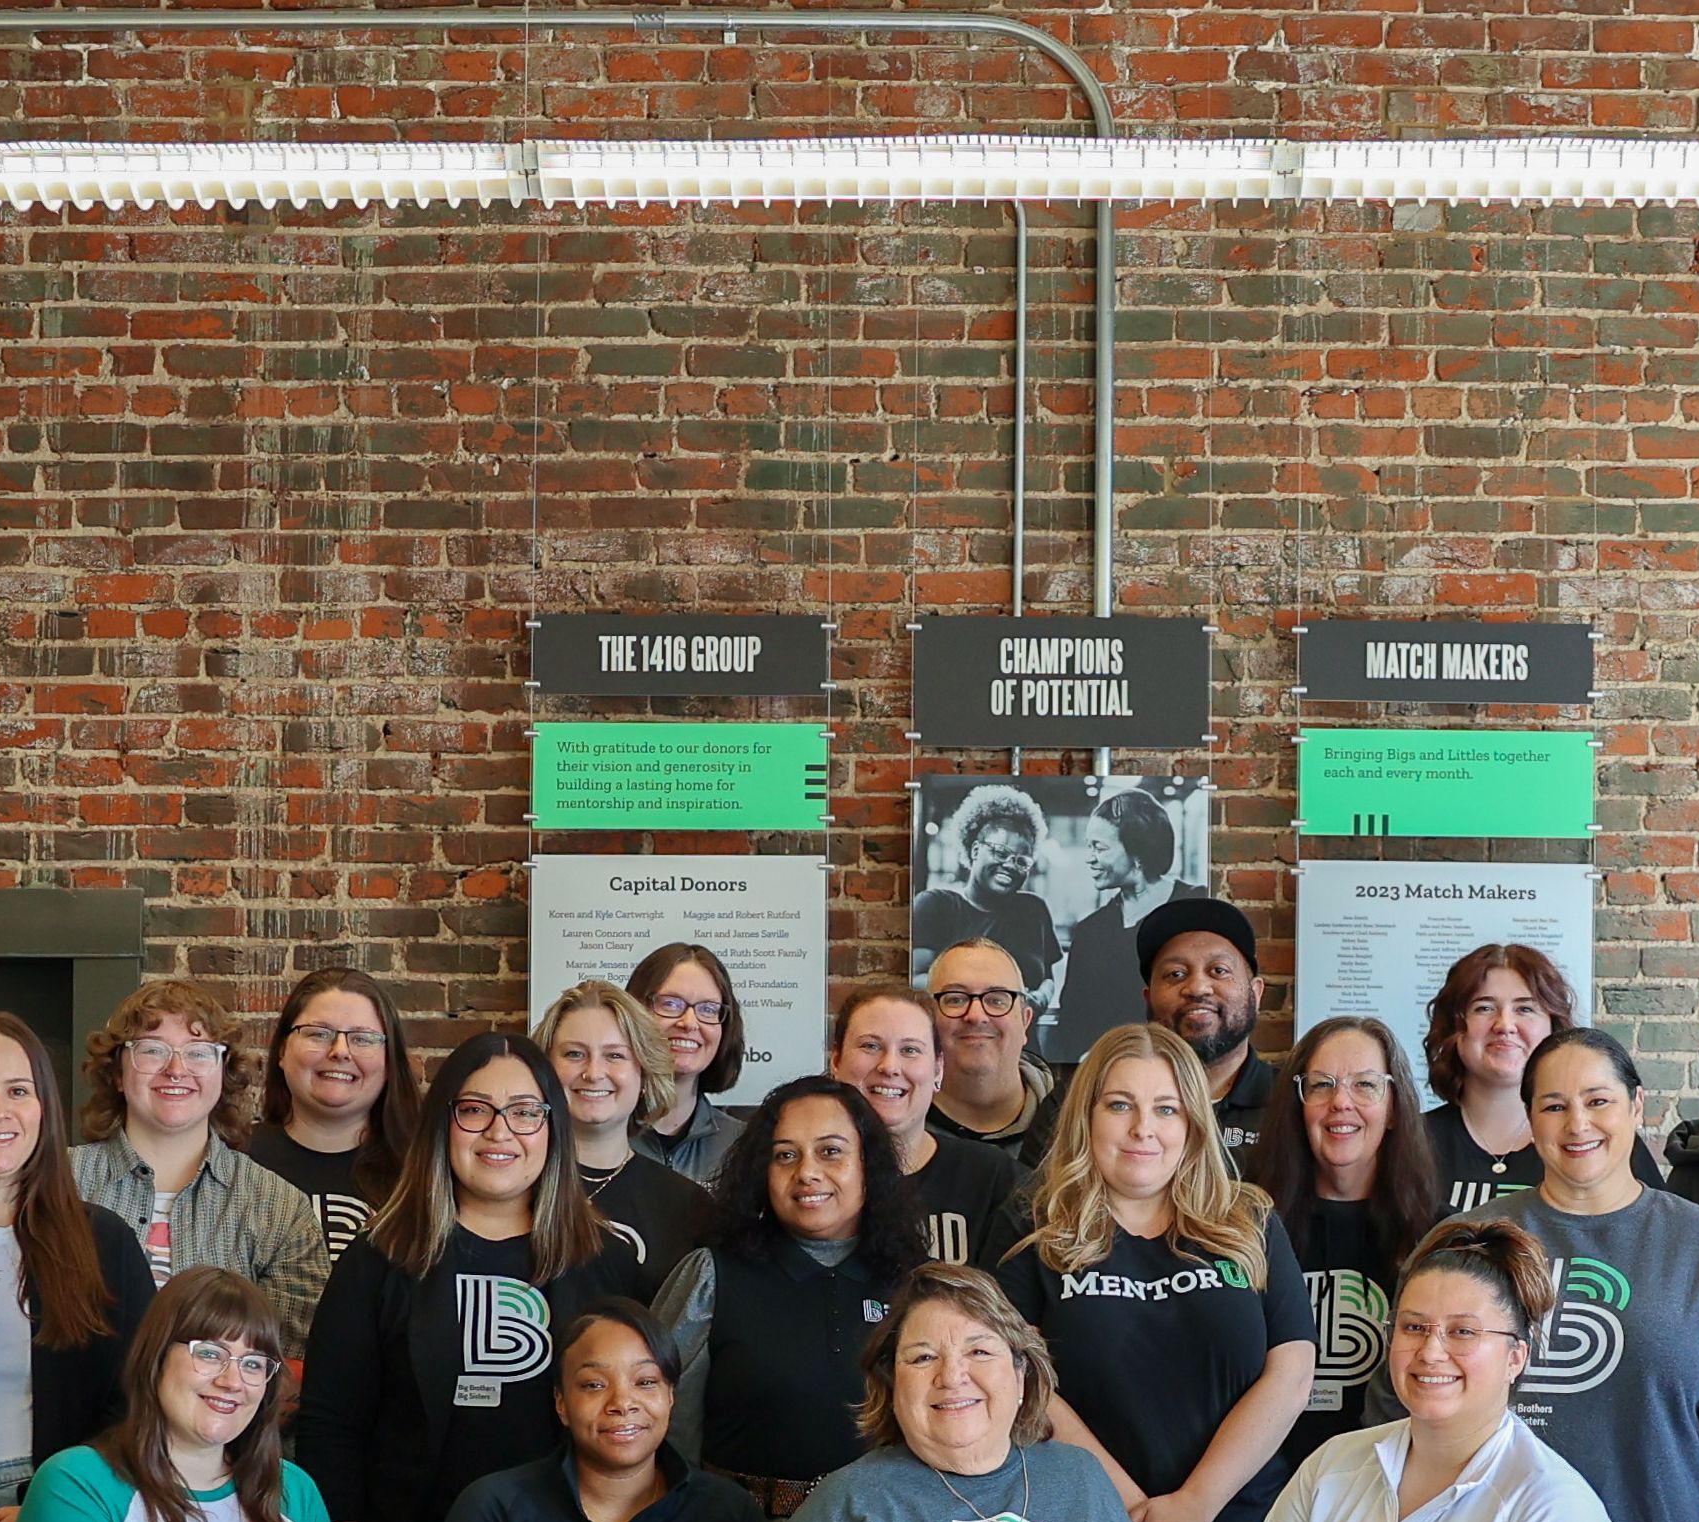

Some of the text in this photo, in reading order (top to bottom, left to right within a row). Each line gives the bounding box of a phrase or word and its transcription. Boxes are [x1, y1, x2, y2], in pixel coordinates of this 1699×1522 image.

[599, 636, 761, 672] THE 1416 GROUP
[1000, 638, 1123, 674] CHAMPIONS
[1366, 642, 1529, 680] MATCH MAKERS
[991, 679, 1133, 716] OF POTENTIAL
[557, 741, 771, 758] With gratitude to our donors for
[1324, 747, 1551, 766] Bringing Bigs and Littles together
[556, 760, 751, 777] their vision and generosity in
[1324, 767, 1474, 782] each and every month.
[557, 778, 735, 794] building a lasting home for
[557, 797, 743, 812] mentorship and inspiration.
[610, 876, 747, 895] Capital Donors
[1356, 884, 1537, 901] 2023 Match Makers
[549, 910, 664, 921] Koren and Kyle Cartwright
[684, 910, 715, 921] Maggie
[717, 910, 733, 919] and
[735, 910, 764, 919] Robert
[562, 929, 650, 938] Lauren Connors and
[694, 929, 789, 938] Kari and James Saville
[579, 941, 634, 951] Jason Cleary
[730, 949, 751, 958] Ruth
[753, 949, 775, 958] Scott
[777, 949, 807, 959] Family
[566, 960, 596, 969] Marnie
[598, 960, 628, 969] Jensen
[723, 961, 766, 969] oundation
[749, 980, 798, 989] Foundation
[759, 999, 792, 1009] Whaley
[1517, 1403, 1553, 1414] Brothers
